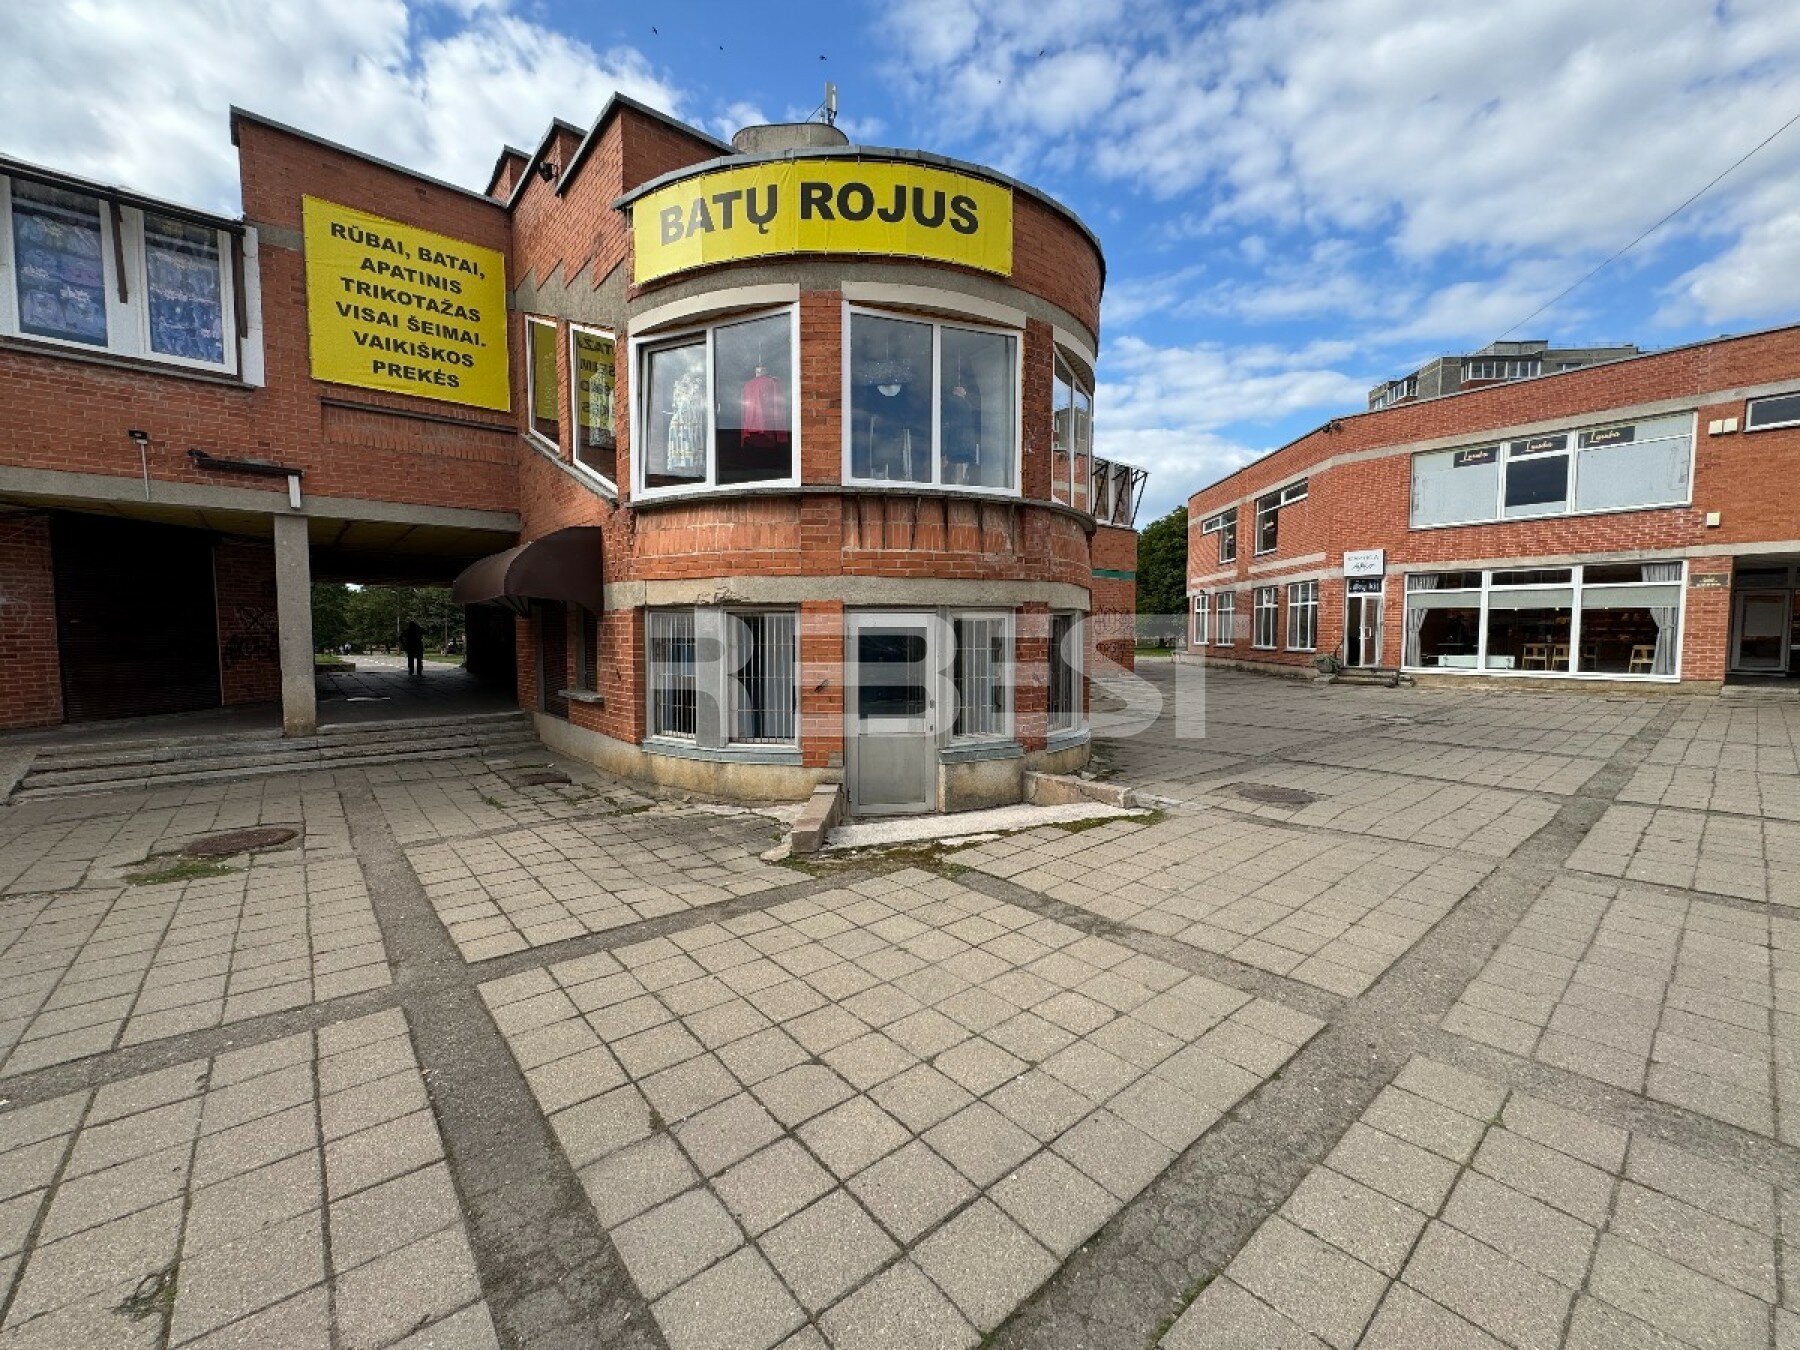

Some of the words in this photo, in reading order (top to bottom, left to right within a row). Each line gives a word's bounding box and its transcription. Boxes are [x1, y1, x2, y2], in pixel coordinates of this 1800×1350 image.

[660, 183, 779, 246] BATŲ
[800, 182, 979, 235] ROJUS
[330, 221, 411, 260] RŪBAI,
[417, 246, 486, 280] BATAI,
[340, 276, 482, 323] TRIKOTAŽAS
[360, 257, 463, 295] APATINIS
[335, 301, 399, 328] VISAI
[406, 314, 487, 348] ŠEIMAI.
[353, 330, 475, 368] VAIKIŠKOS
[372, 359, 460, 388] PREKĖS
